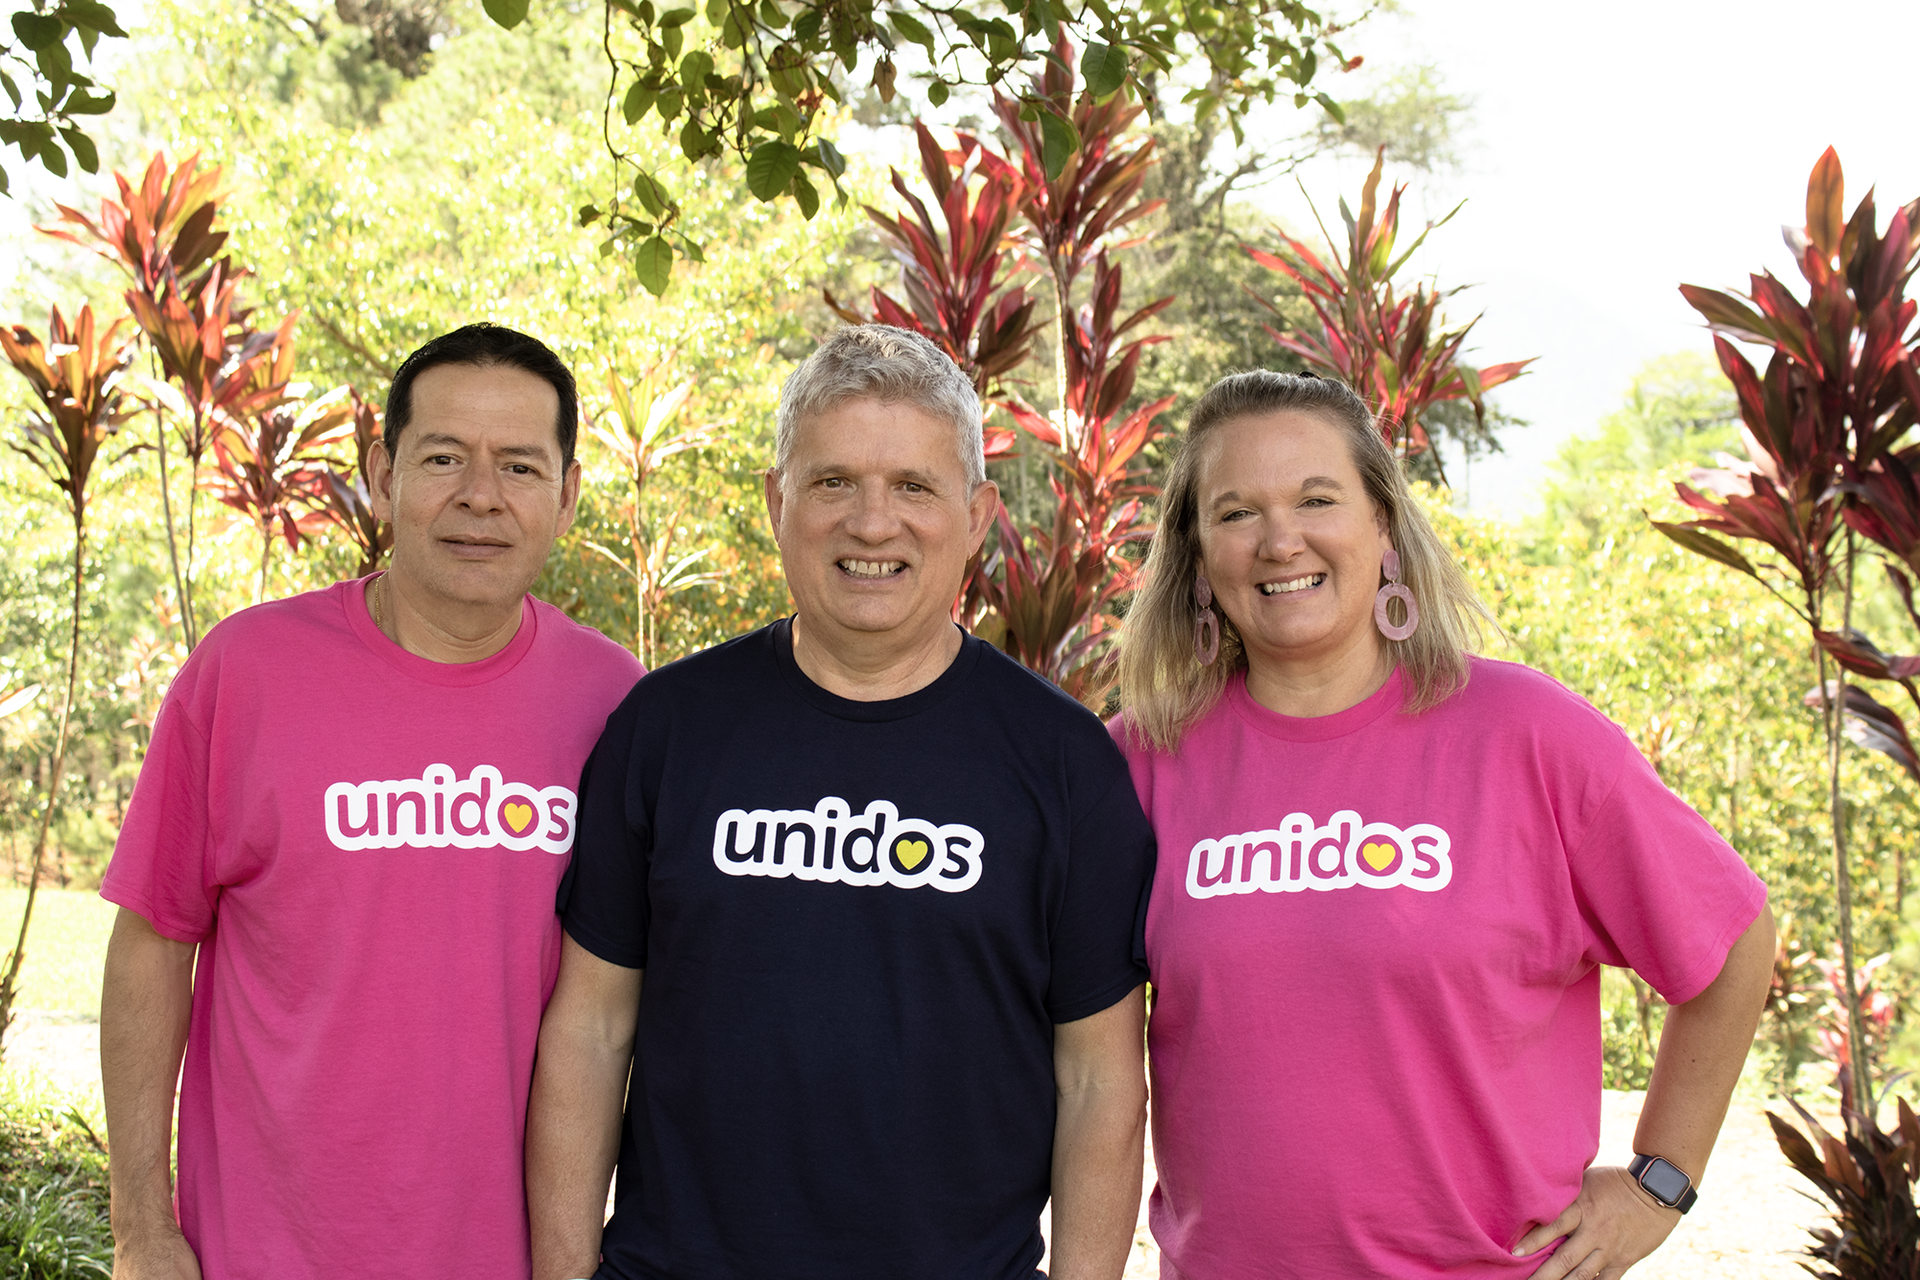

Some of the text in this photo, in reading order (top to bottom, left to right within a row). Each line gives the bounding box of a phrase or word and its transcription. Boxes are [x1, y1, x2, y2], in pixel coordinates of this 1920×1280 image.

[337, 775, 570, 842] unidos
[725, 809, 972, 880] unidos
[1196, 822, 1440, 888] unidos
